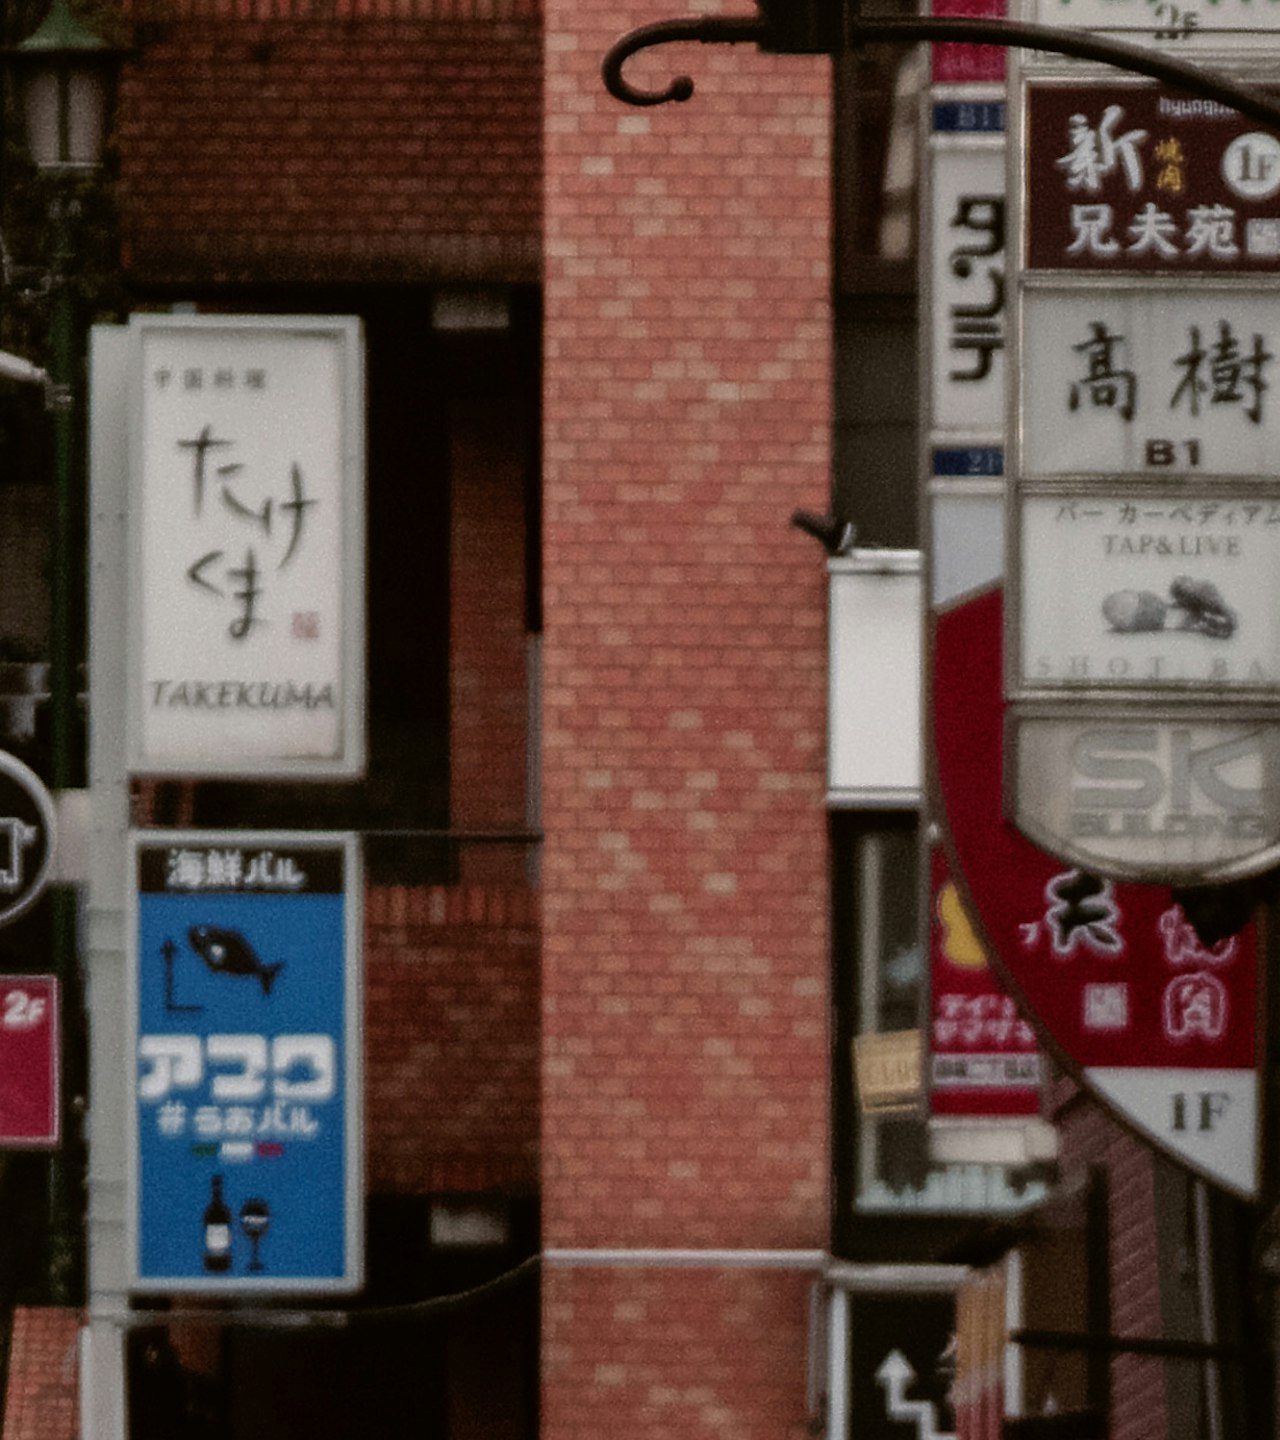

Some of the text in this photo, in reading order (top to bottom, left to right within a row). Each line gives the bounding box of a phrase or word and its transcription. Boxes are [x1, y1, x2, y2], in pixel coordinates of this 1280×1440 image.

[1152, 3, 1200, 42] 2F
[1055, 103, 1150, 192] 新
[1237, 143, 1278, 183] 1F
[1065, 202, 1240, 258] 兄夫苑
[1067, 317, 1276, 425] 高樹
[1144, 438, 1201, 468] B1
[150, 678, 336, 711] TAKEKUMA
[1071, 727, 1266, 810] SK
[165, 848, 308, 890] 海鮮バル
[3, 989, 47, 1027] 2F
[1170, 1091, 1230, 1131] 1F
